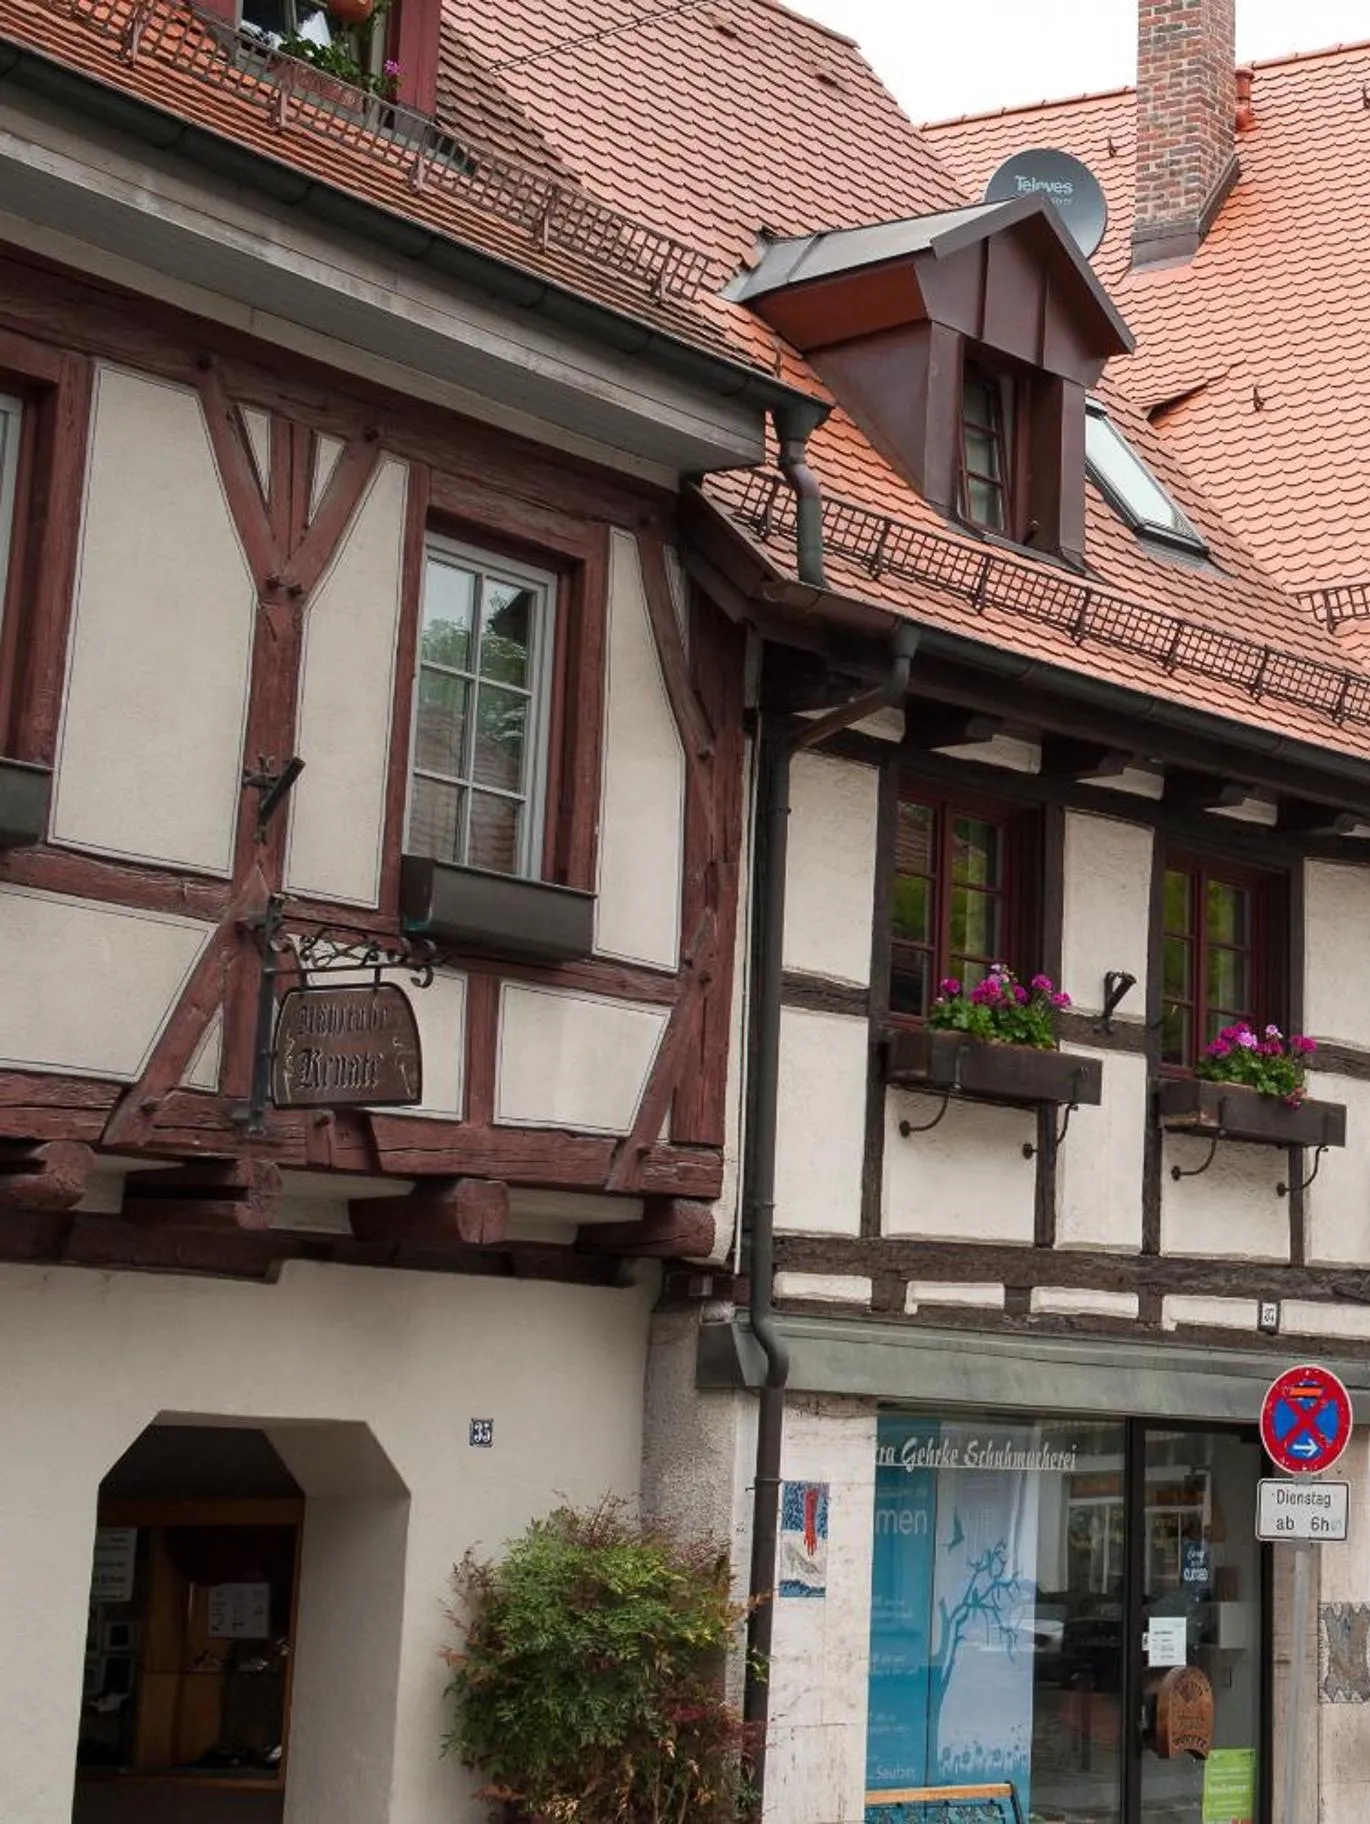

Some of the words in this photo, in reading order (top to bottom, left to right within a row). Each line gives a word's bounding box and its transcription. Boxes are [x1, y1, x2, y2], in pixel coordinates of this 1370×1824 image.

[474, 1421, 490, 1442] 35
[901, 1437, 958, 1472] Gehrke
[964, 1438, 1077, 1471] Schuhmacherei
[1277, 1489, 1331, 1509] Dienstag
[1277, 1516, 1294, 1530] ab
